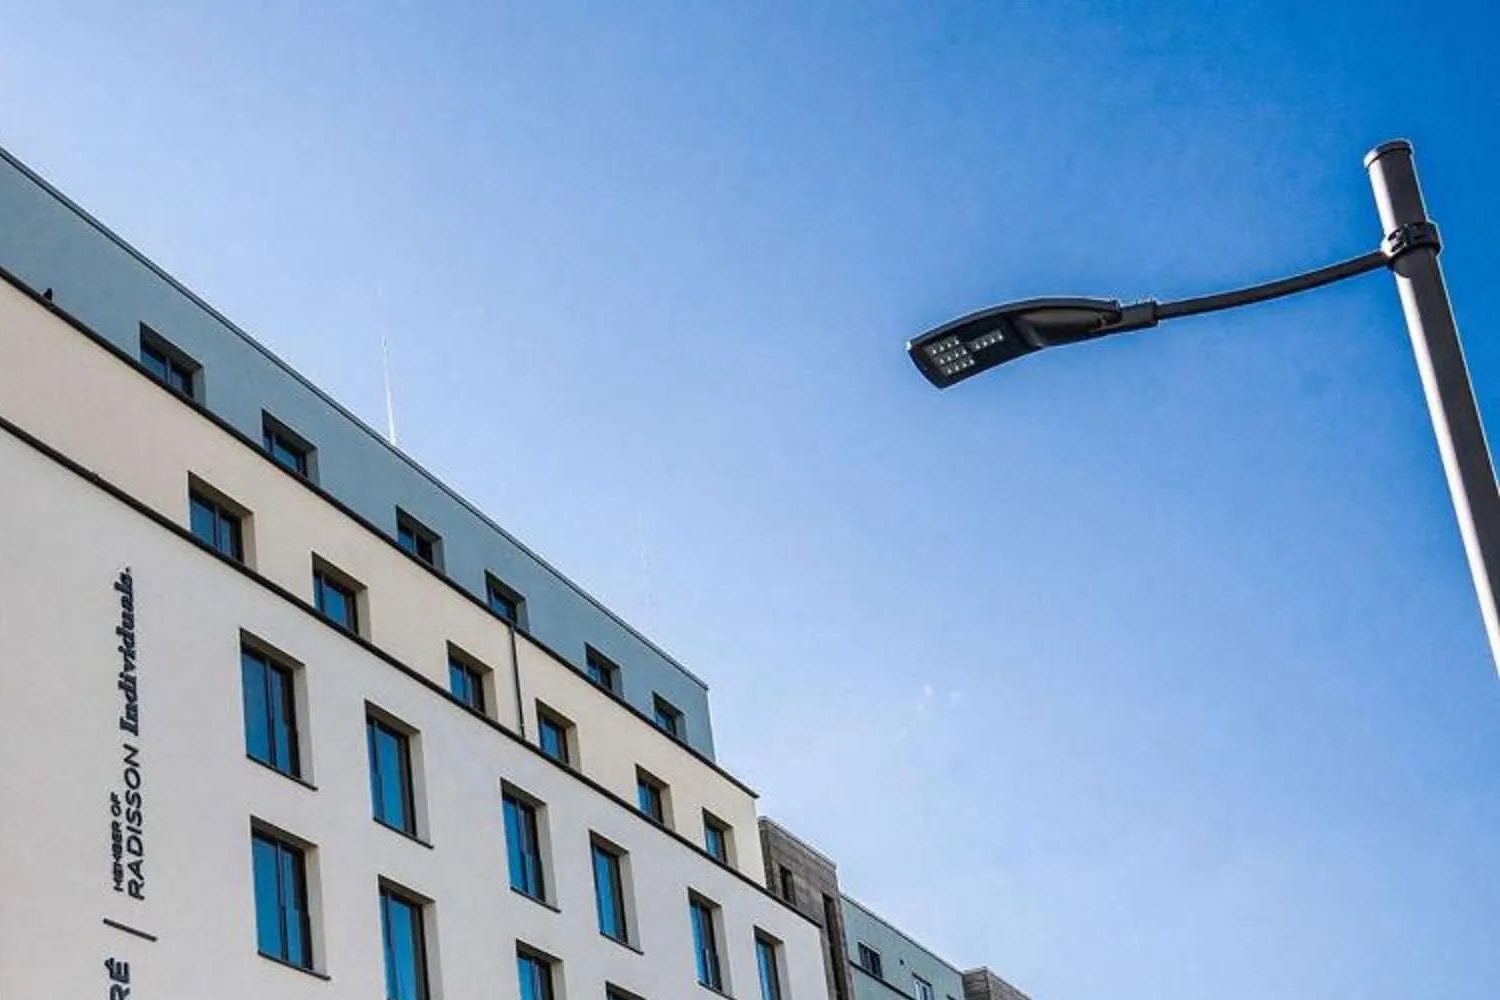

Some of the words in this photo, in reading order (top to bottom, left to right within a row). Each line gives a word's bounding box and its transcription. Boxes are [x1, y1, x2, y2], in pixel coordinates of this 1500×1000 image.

[109, 791, 122, 818] OF
[122, 743, 145, 901] RADISSON
[110, 819, 125, 893] MEMBER
